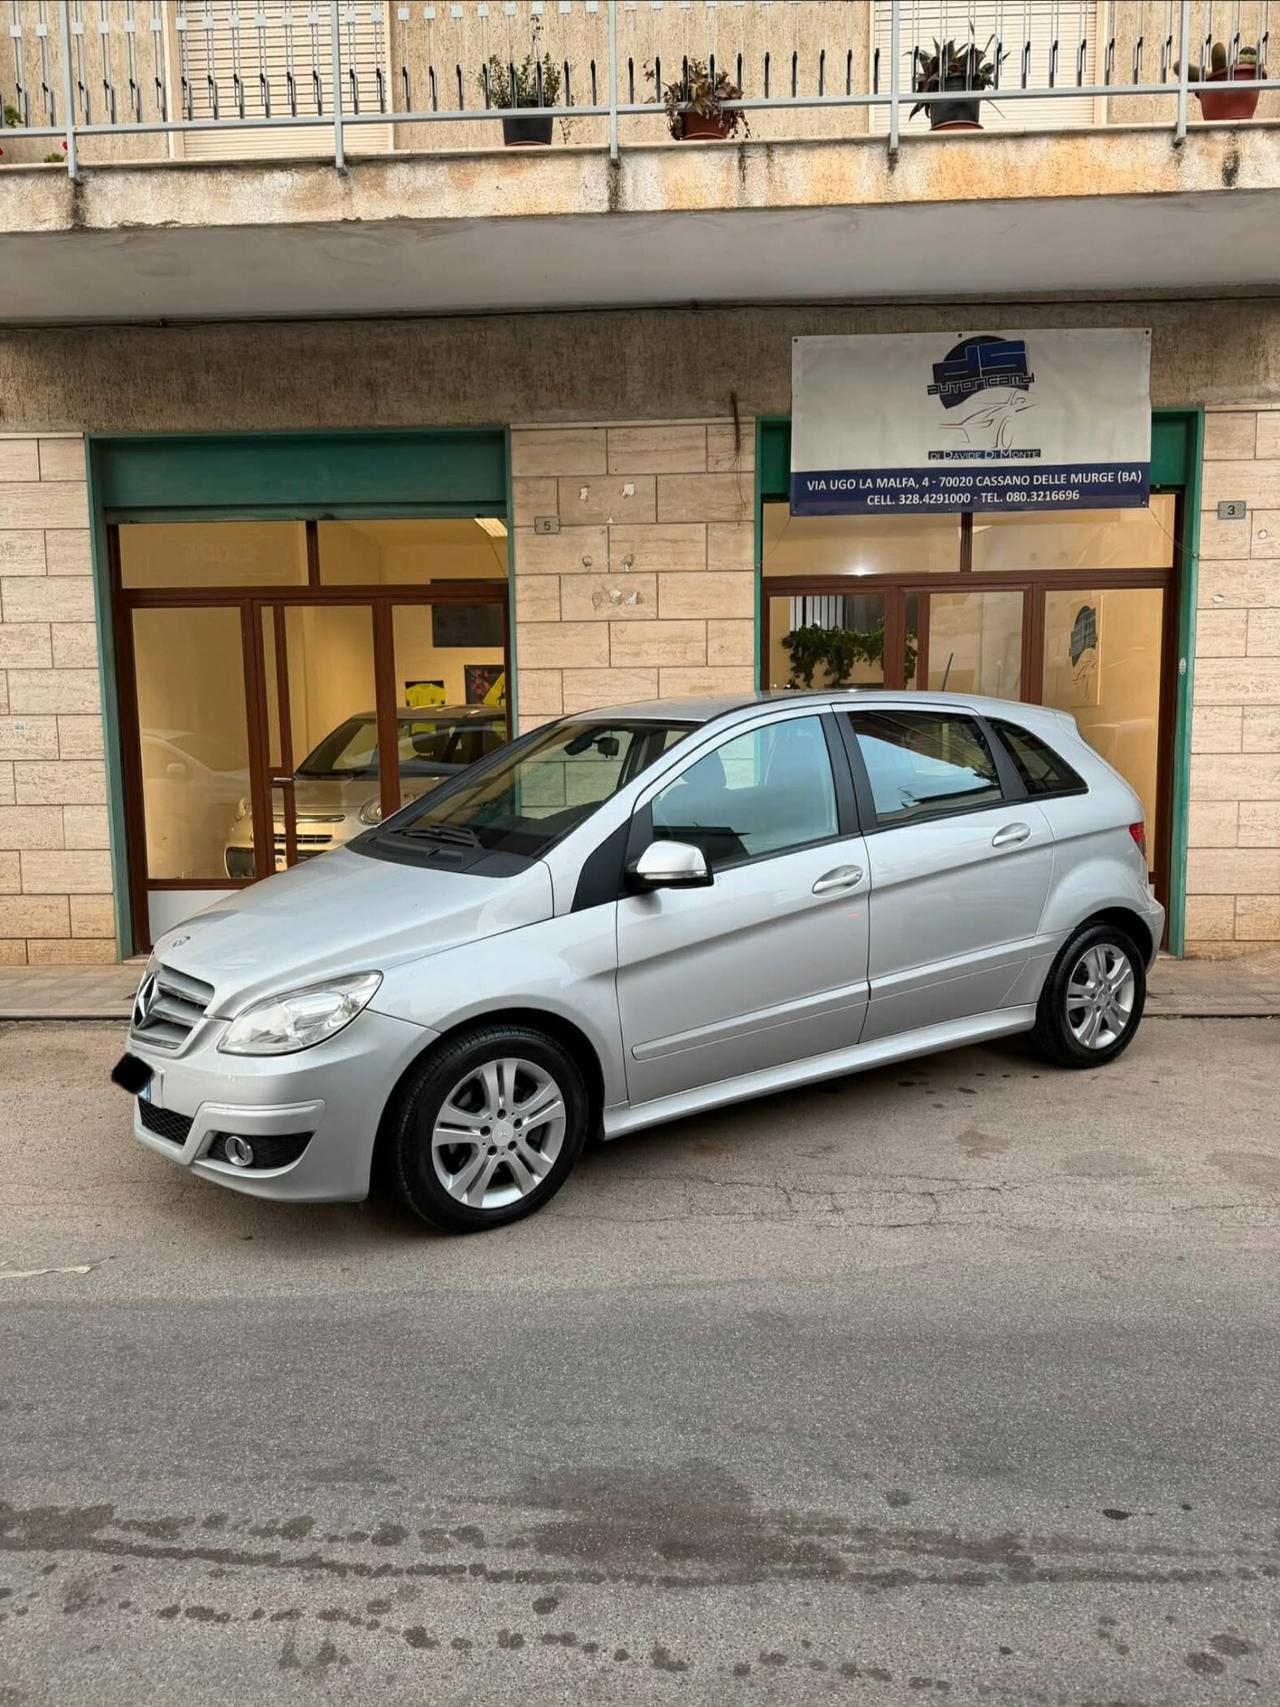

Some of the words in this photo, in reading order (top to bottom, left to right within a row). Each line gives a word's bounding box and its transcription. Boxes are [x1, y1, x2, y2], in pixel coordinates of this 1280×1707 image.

[807, 480, 827, 491] VIA
[829, 479, 856, 490] UGO
[859, 478, 873, 489] LA
[876, 477, 919, 489] MALFA,
[922, 477, 929, 487] 4
[939, 476, 973, 487] 70020
[976, 475, 1030, 487] CASSANO
[1033, 474, 1067, 485] DELLE
[1070, 472, 1114, 484] MURGE
[1117, 471, 1142, 484] (BA)
[867, 494, 895, 505] CELL.
[899, 492, 971, 505] 328.4291000
[981, 492, 1003, 503] TEL.
[1006, 490, 1080, 503] 080.3216696
[1227, 504, 1236, 516] 3
[543, 520, 551, 531] 5
